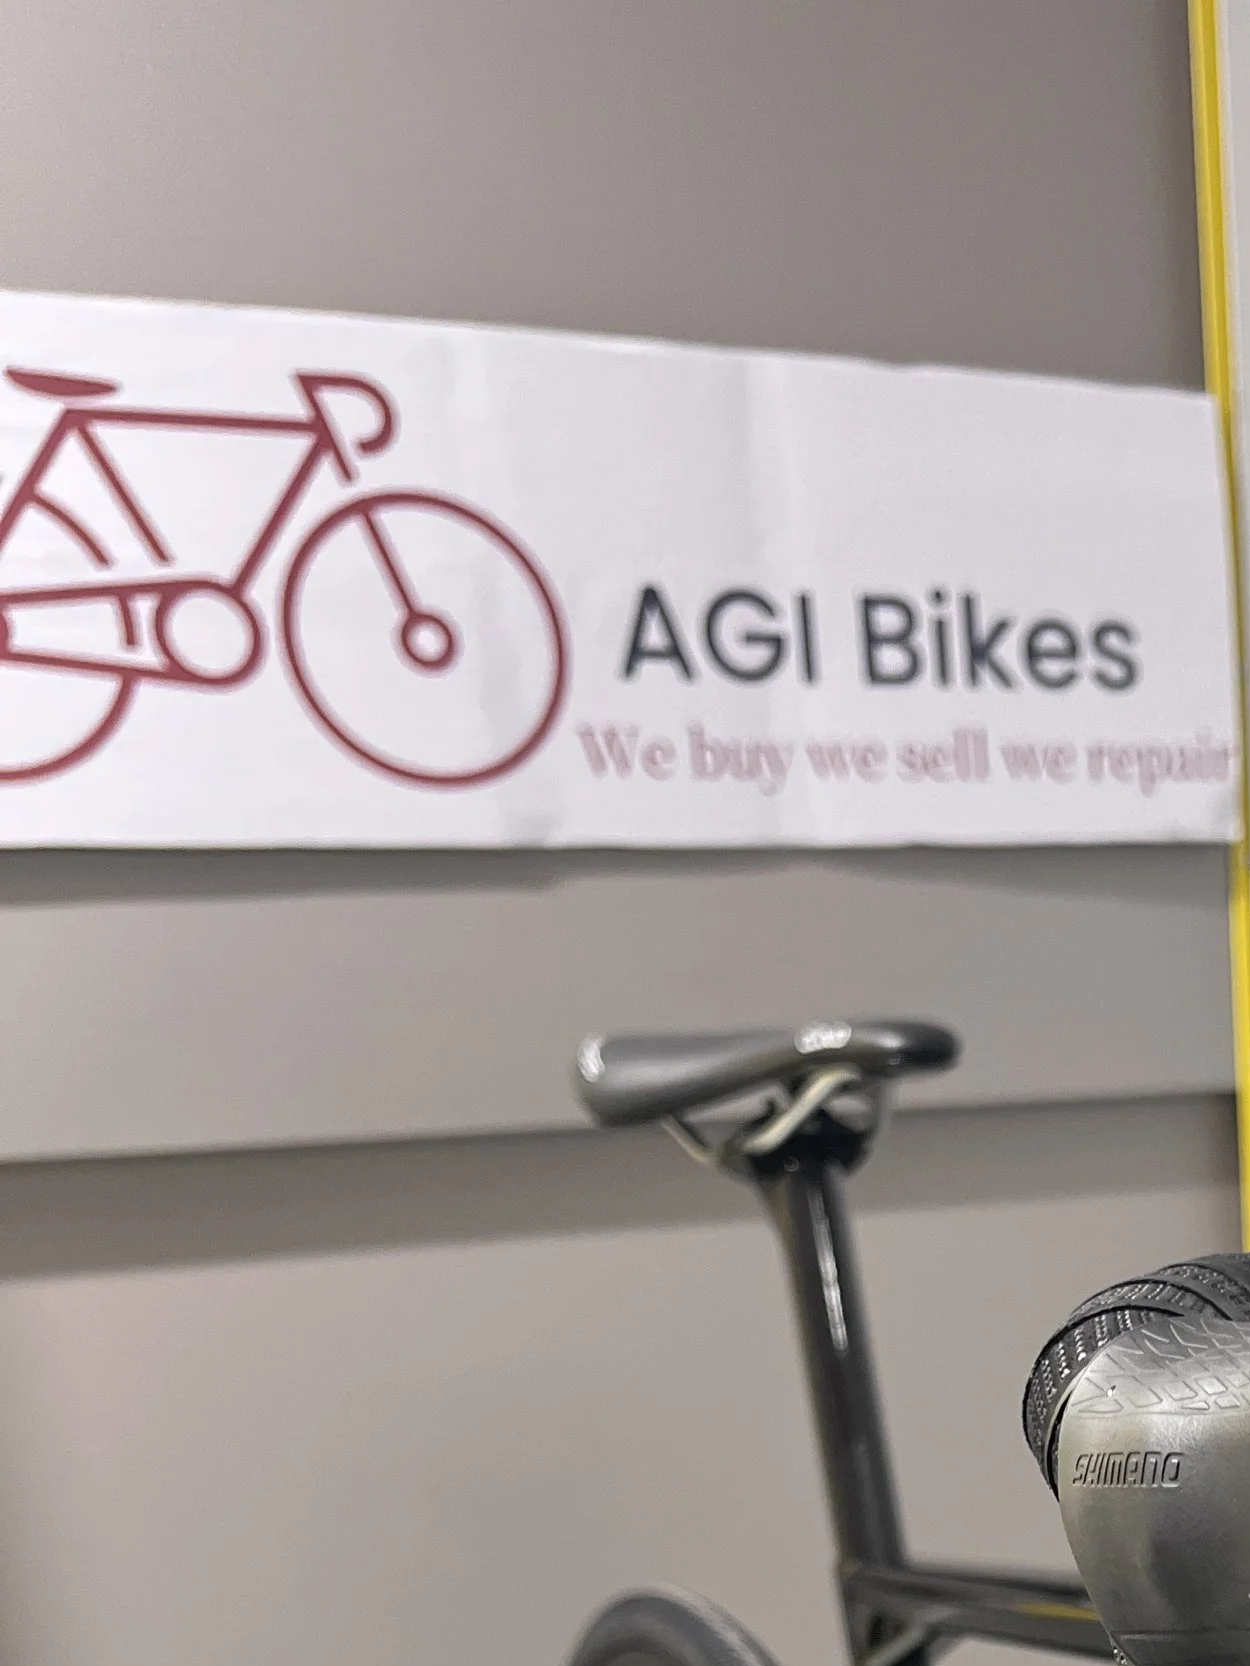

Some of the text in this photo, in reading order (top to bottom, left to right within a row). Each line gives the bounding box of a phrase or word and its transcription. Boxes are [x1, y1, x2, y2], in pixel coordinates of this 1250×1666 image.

[624, 584, 1141, 692] AGI Bikes
[577, 720, 1238, 797] We buy we sell we repair
[1072, 1451, 1185, 1488] SHIMANO
